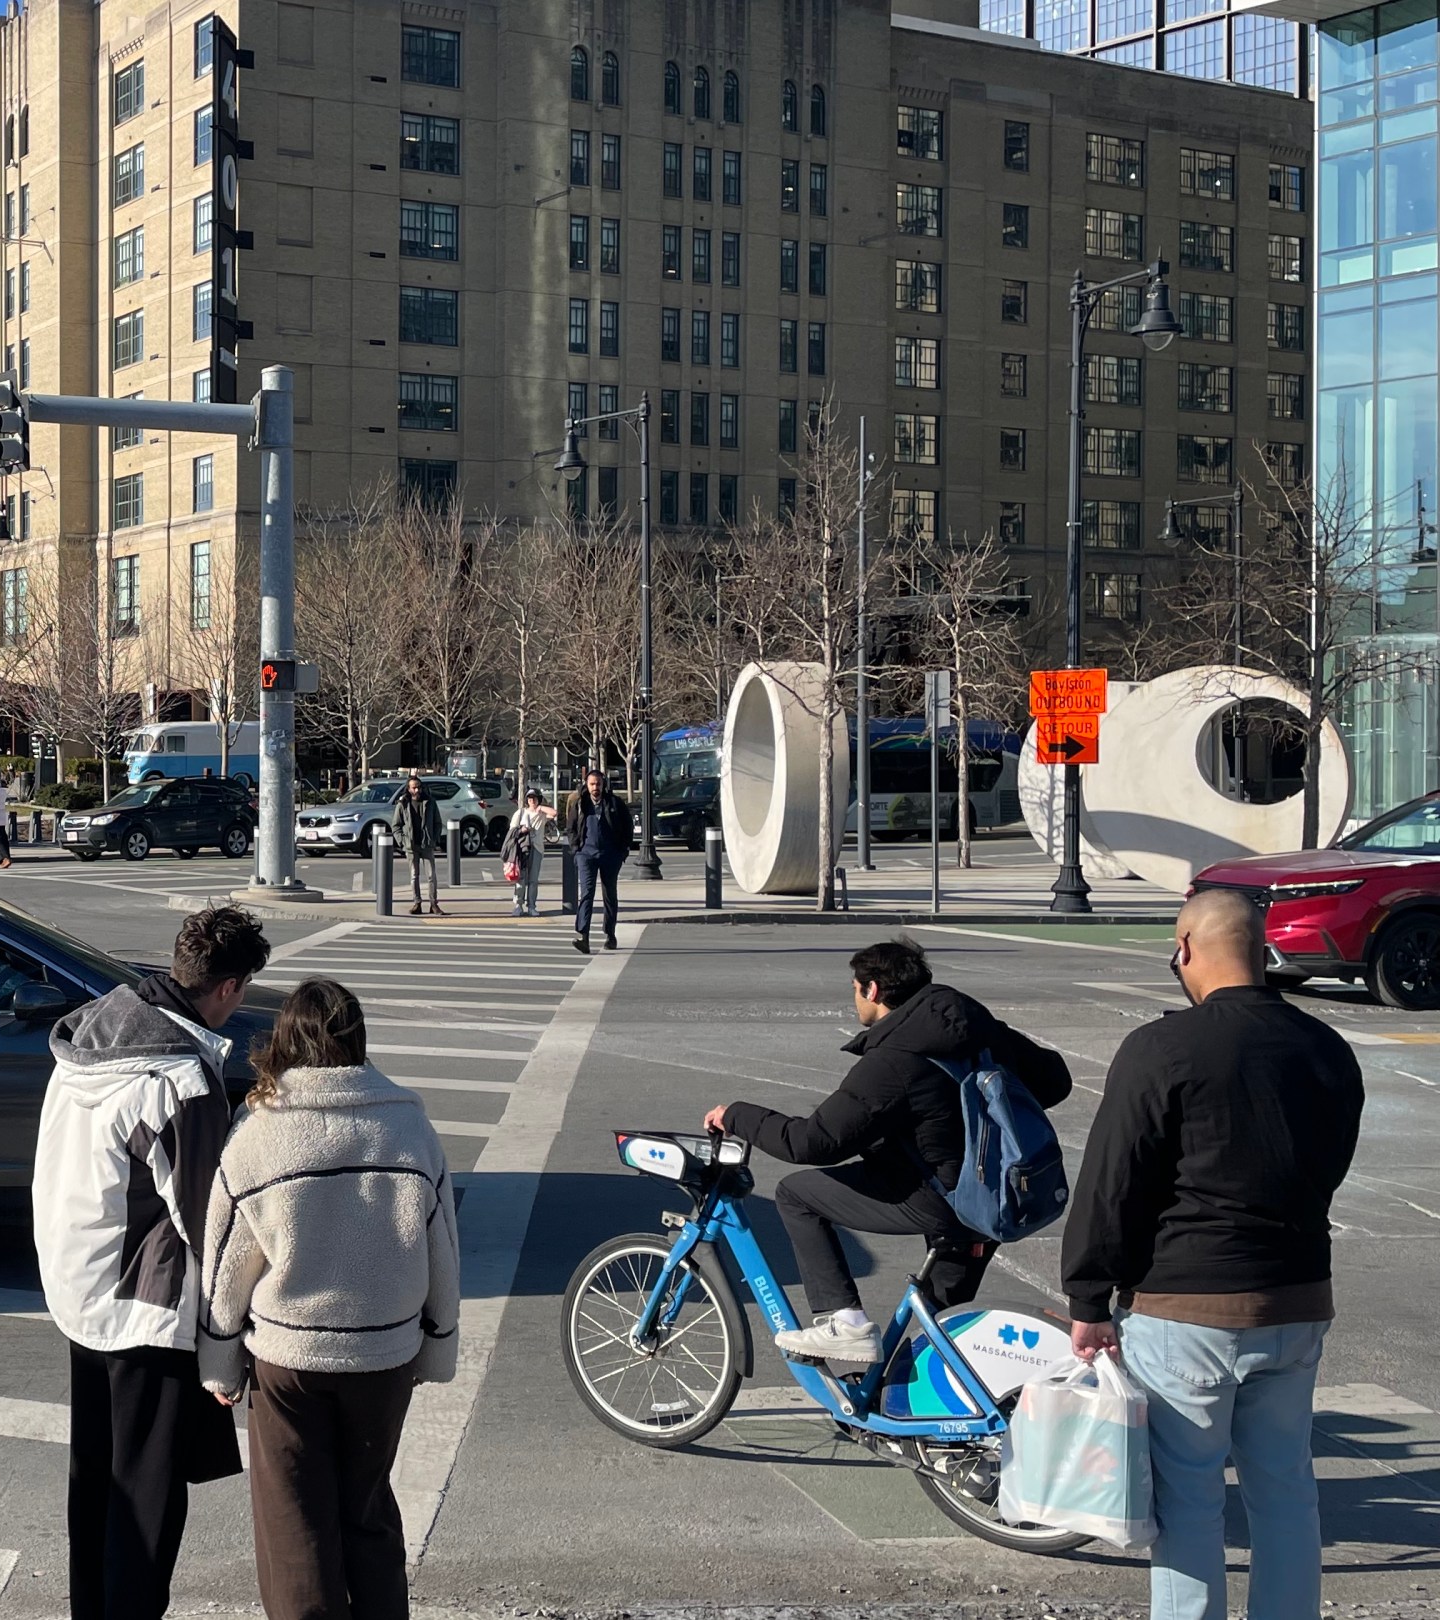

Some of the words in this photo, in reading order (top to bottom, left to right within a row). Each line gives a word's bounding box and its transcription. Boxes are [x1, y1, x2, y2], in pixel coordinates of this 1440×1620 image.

[1045, 677, 1091, 693] Boylston
[1036, 695, 1100, 709] OUTBOUND
[1044, 722, 1093, 735] DETOUR
[754, 1275, 787, 1333] BLUEbik
[972, 1344, 1050, 1367] MASSACHUSET
[938, 1423, 969, 1434] 76795
